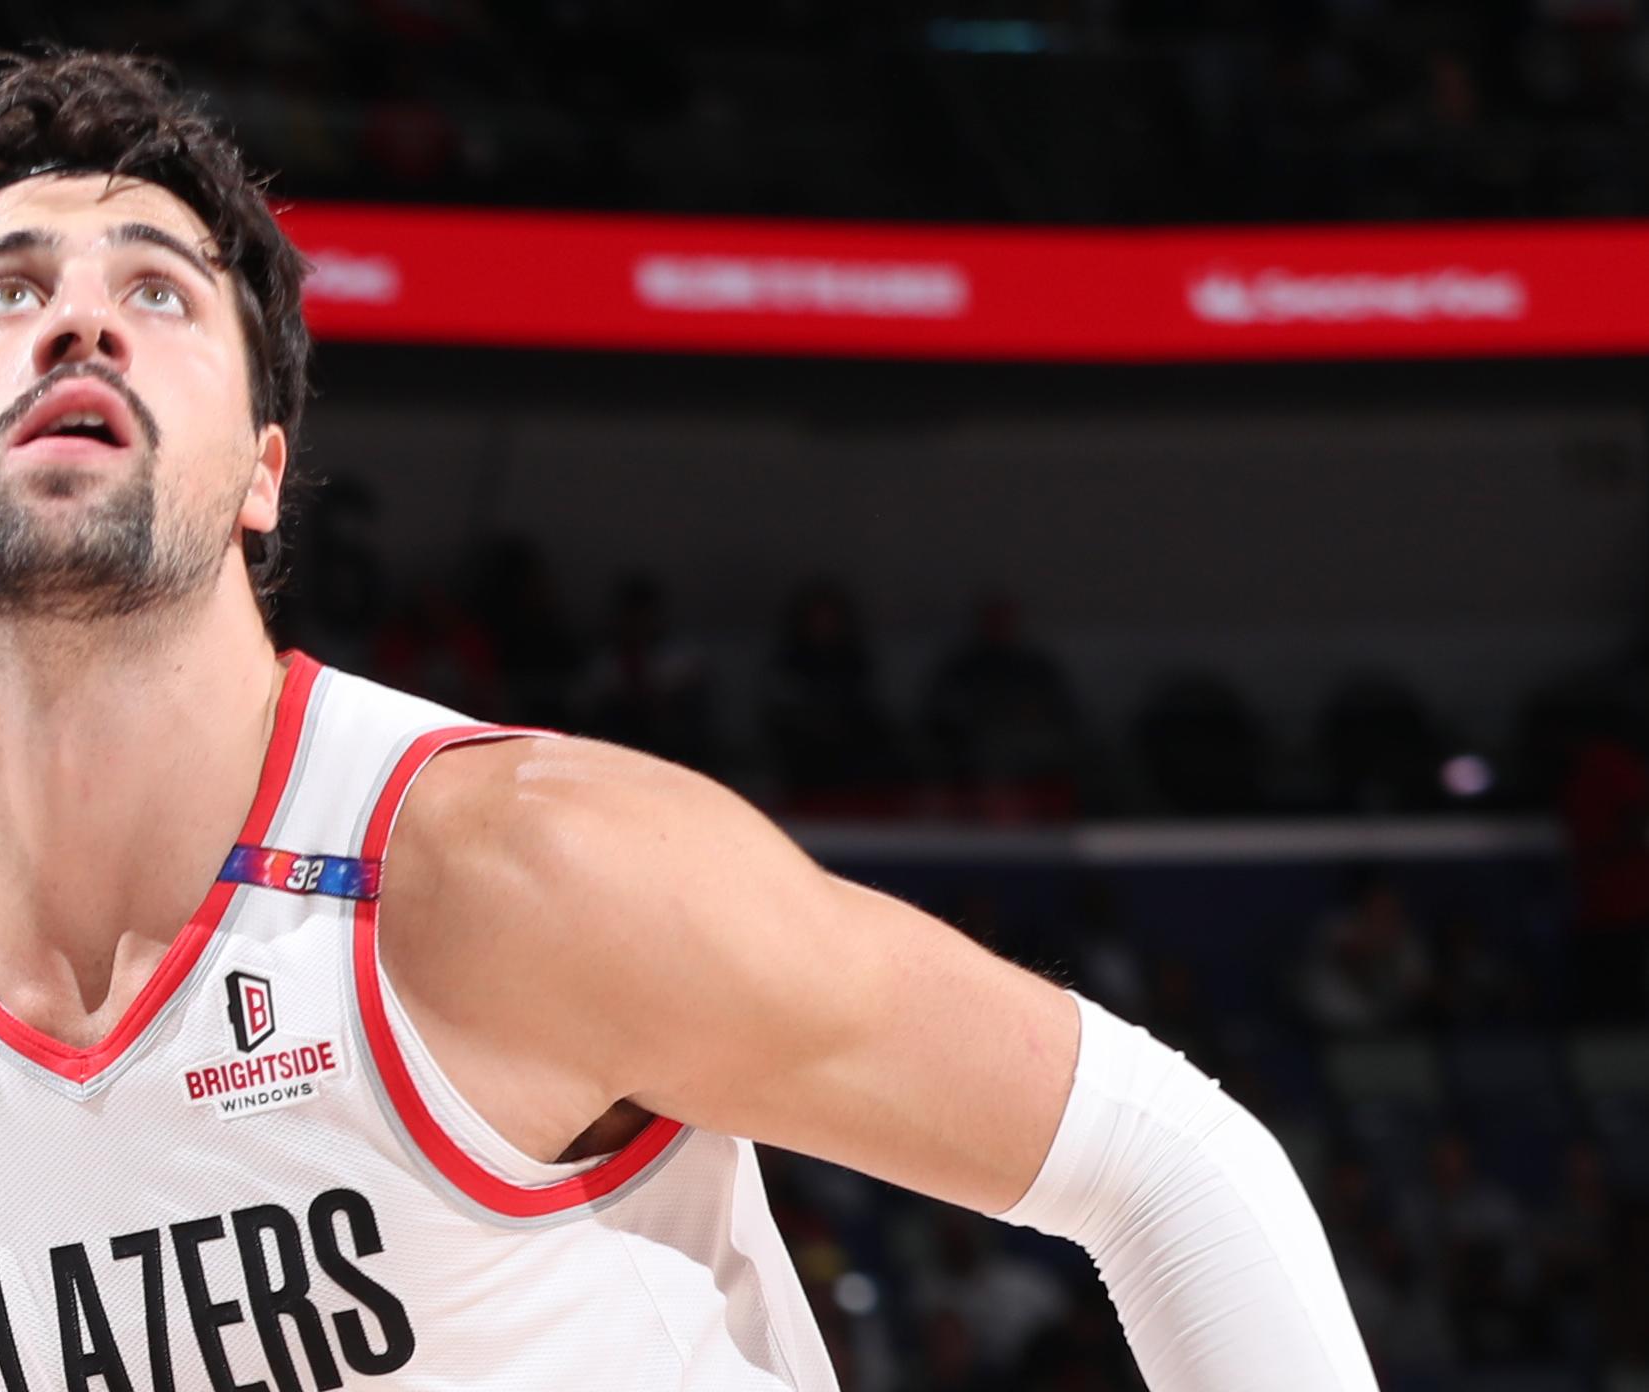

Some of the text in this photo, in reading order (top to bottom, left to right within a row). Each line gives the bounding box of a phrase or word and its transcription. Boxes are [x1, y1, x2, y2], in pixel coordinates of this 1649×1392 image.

[286, 859, 324, 890] 32
[245, 987, 267, 1035] B
[185, 1042, 336, 1100] BRIGHTSIDE
[221, 1083, 313, 1112] WINDOWS
